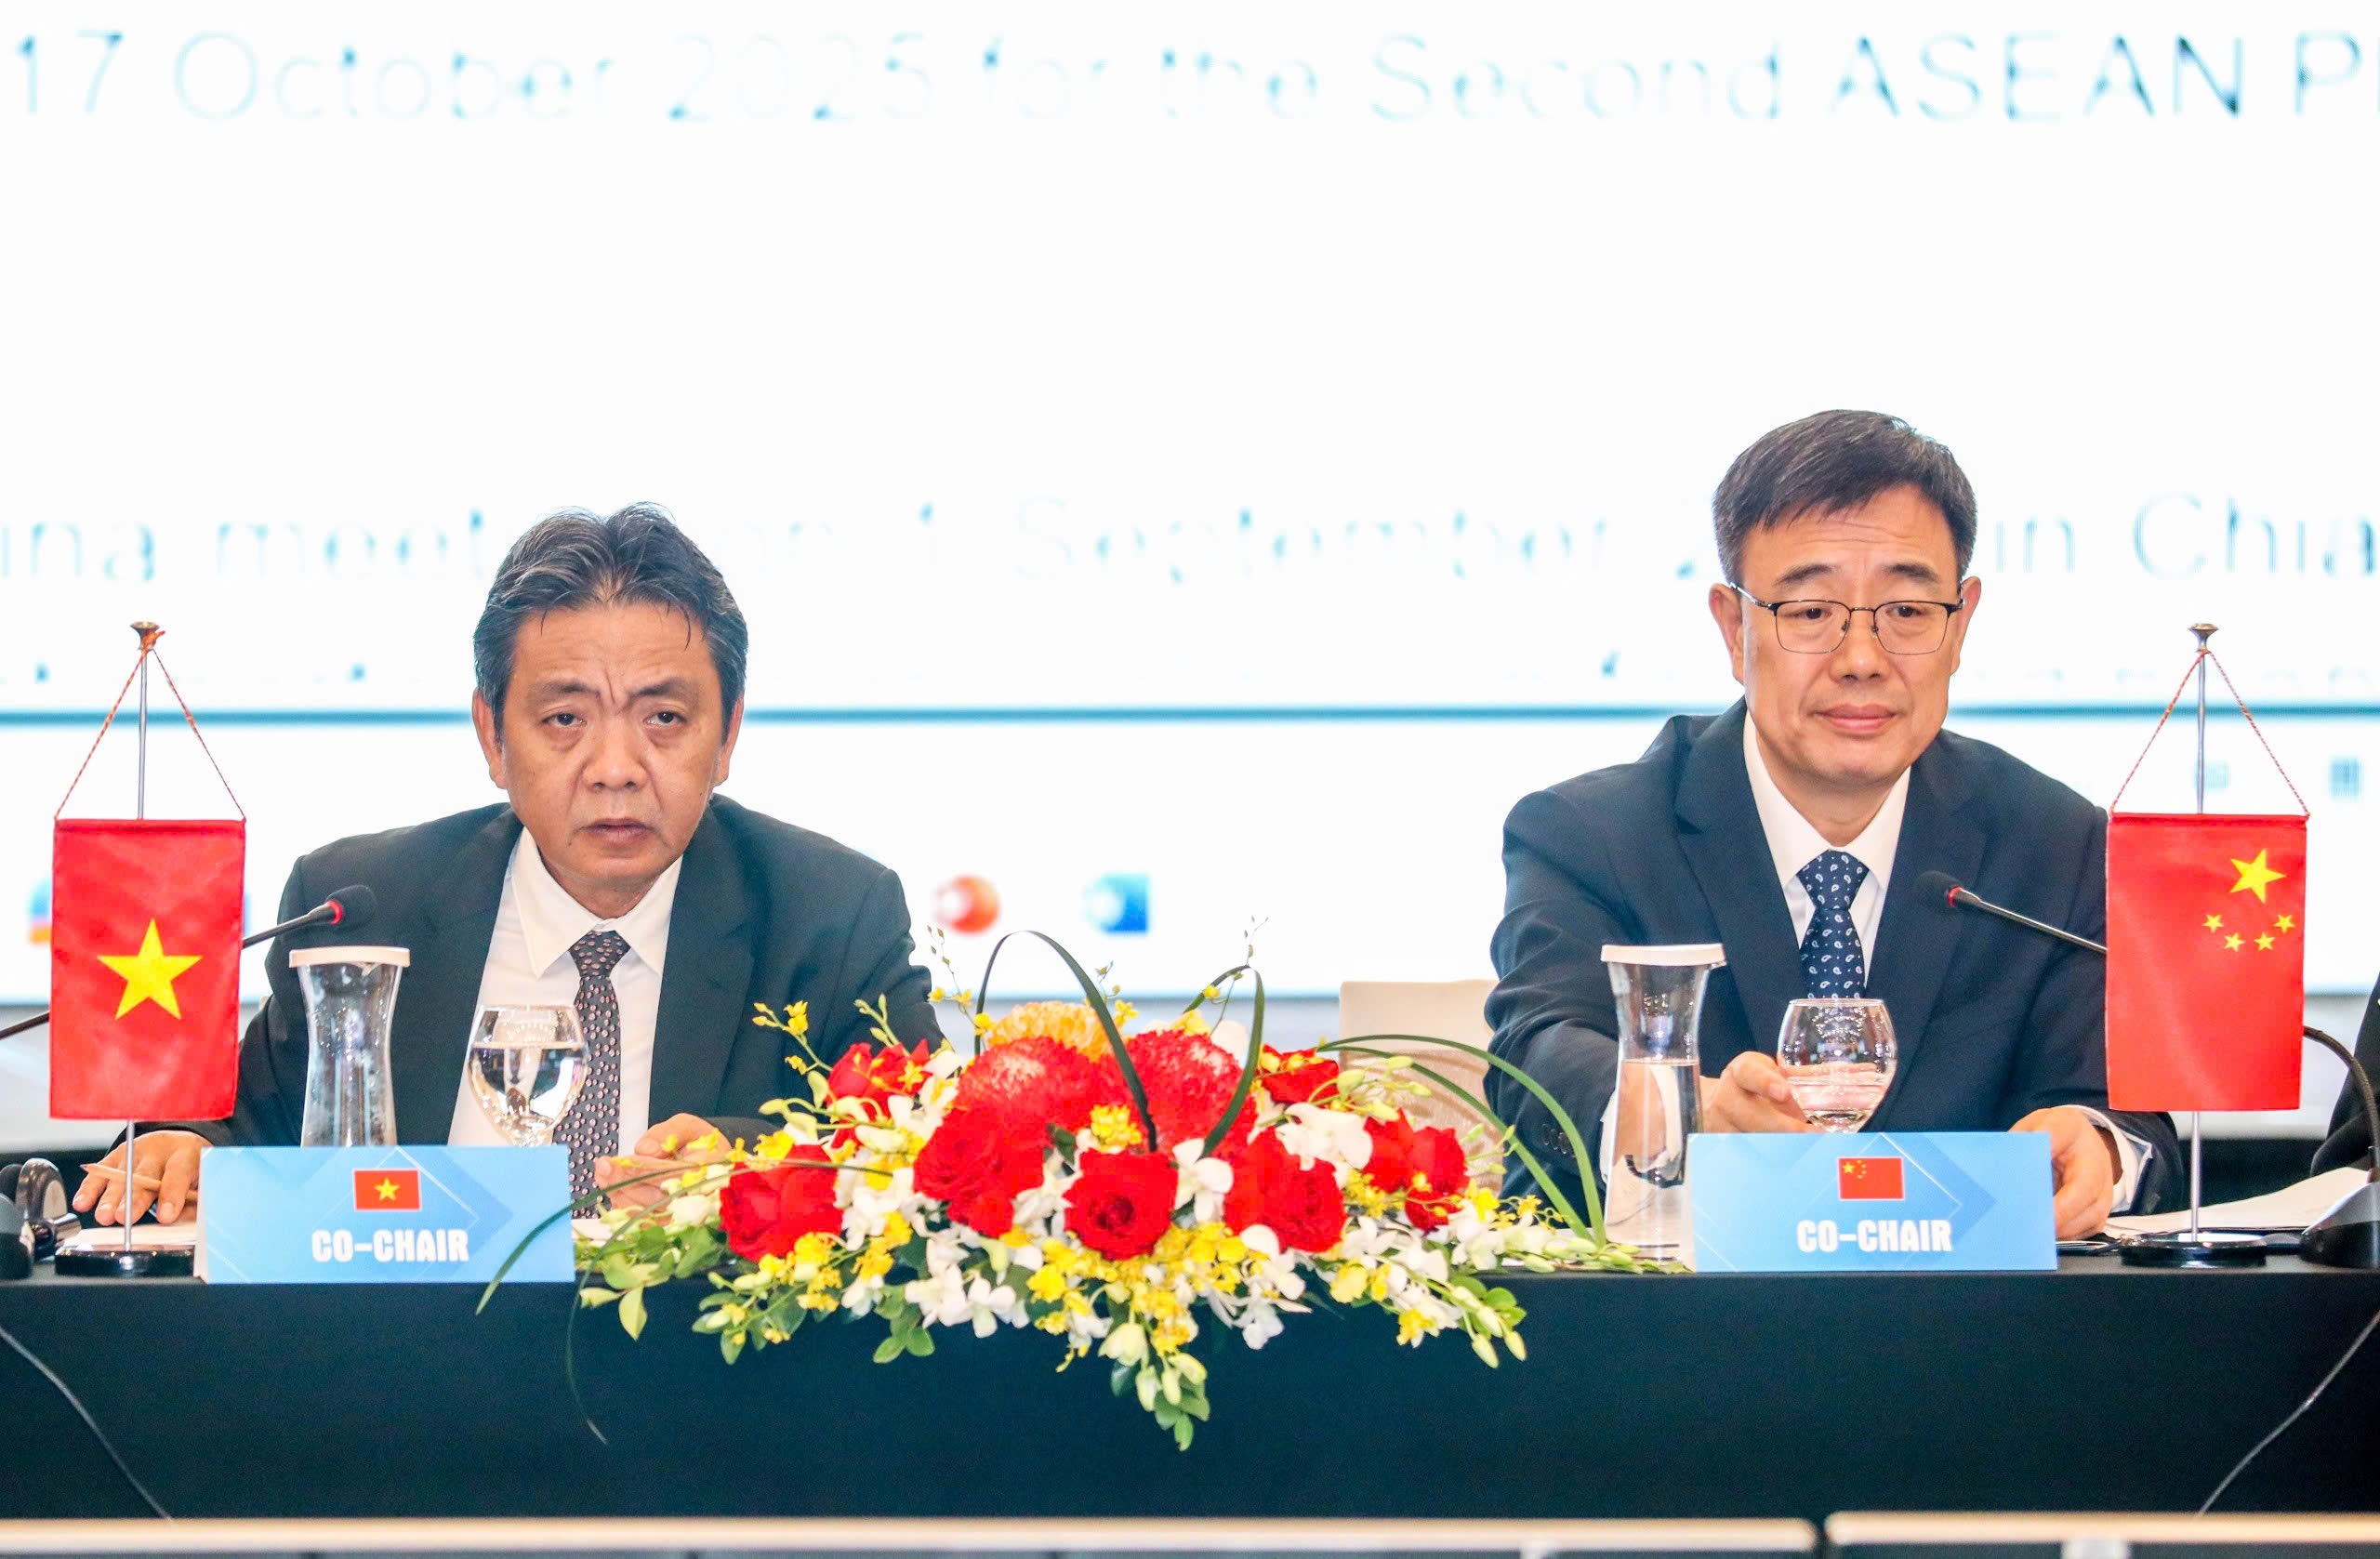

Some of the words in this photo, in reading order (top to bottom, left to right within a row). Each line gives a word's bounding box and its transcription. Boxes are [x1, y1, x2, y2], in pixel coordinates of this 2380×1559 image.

[15, 30, 126, 115] 17
[173, 31, 614, 121] October
[664, 33, 933, 125] 2025
[979, 33, 1113, 121] for
[1370, 32, 1781, 122] Second
[1830, 33, 2243, 121] ASEAN
[216, 505, 489, 581] meet
[1993, 514, 2076, 575] in
[311, 1228, 469, 1262] CO-CHAIR
[1797, 1219, 1952, 1252] CO-CHAIR
